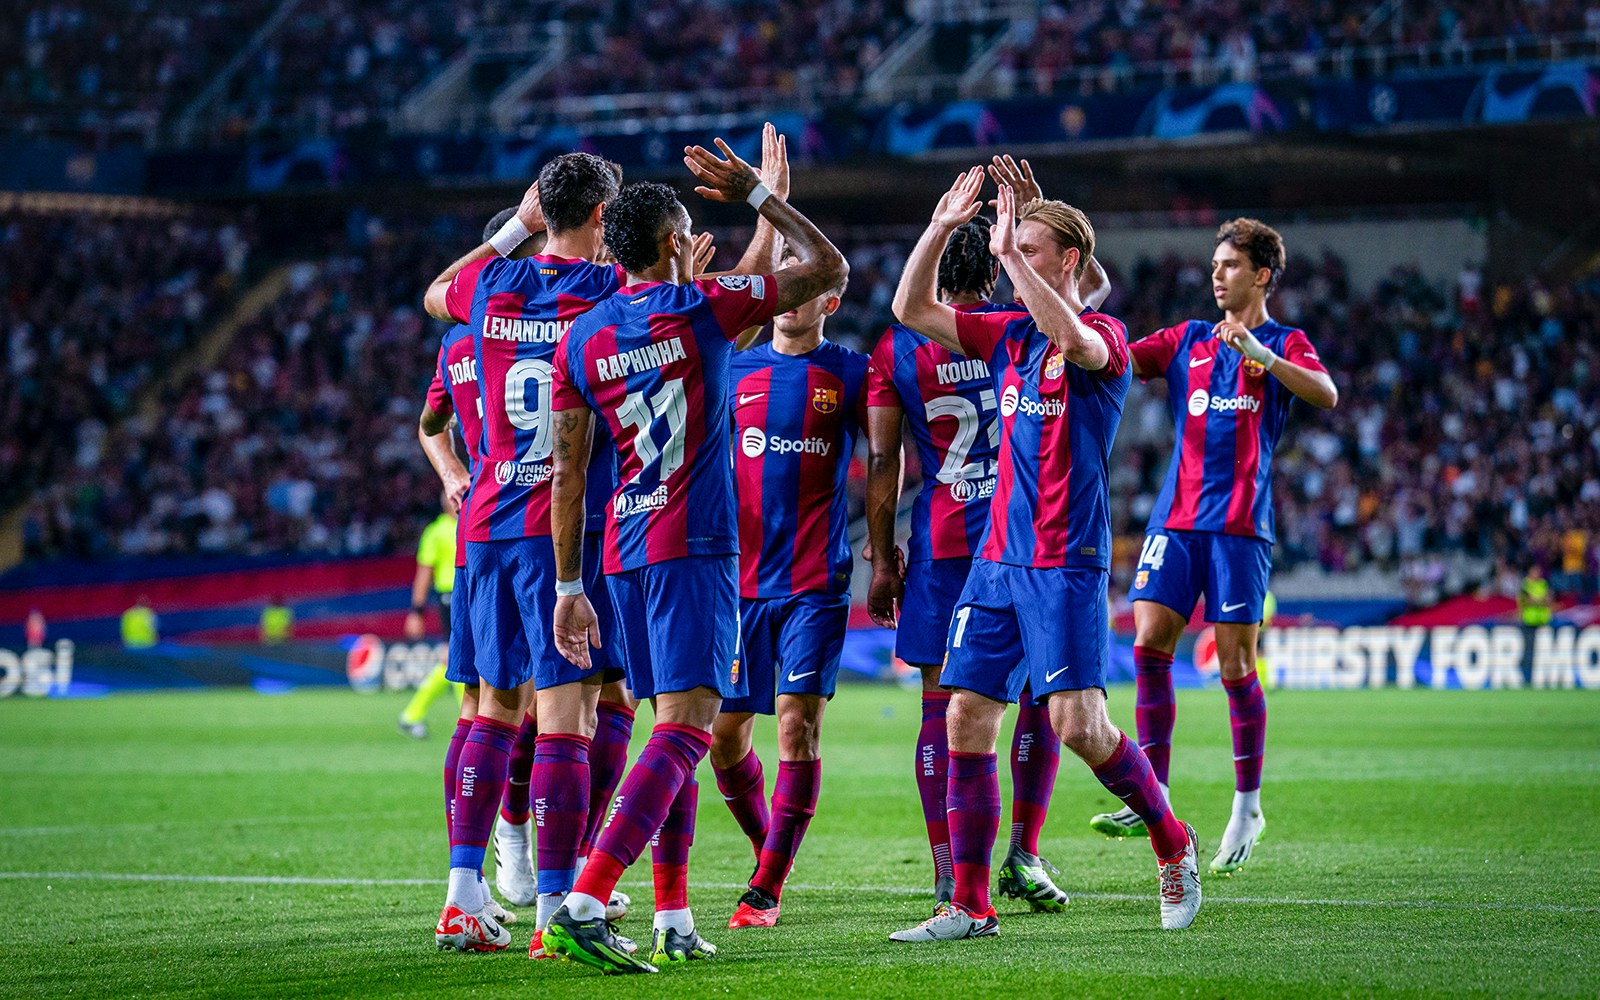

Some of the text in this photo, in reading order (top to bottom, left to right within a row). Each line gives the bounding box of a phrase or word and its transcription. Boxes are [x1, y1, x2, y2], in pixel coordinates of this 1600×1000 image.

[483, 315, 574, 344] LEWANDOW
[596, 336, 687, 382] RAPHINHA
[505, 358, 554, 464] 9
[1018, 396, 1066, 418] Spotify
[1210, 394, 1260, 413] Spotify
[615, 377, 688, 485] 11
[769, 435, 831, 457] Spotify
[517, 464, 552, 476] UNHC
[1137, 534, 1169, 571] 14
[952, 606, 972, 648] 1
[1262, 625, 1426, 690] HIRSTY
[1429, 624, 1524, 690] FOR
[923, 744, 934, 776] BARÇA
[1017, 732, 1034, 762] BARÇA
[461, 766, 475, 797] BARÇA
[536, 797, 549, 827] BARÇA
[604, 795, 625, 828] BARÇA
